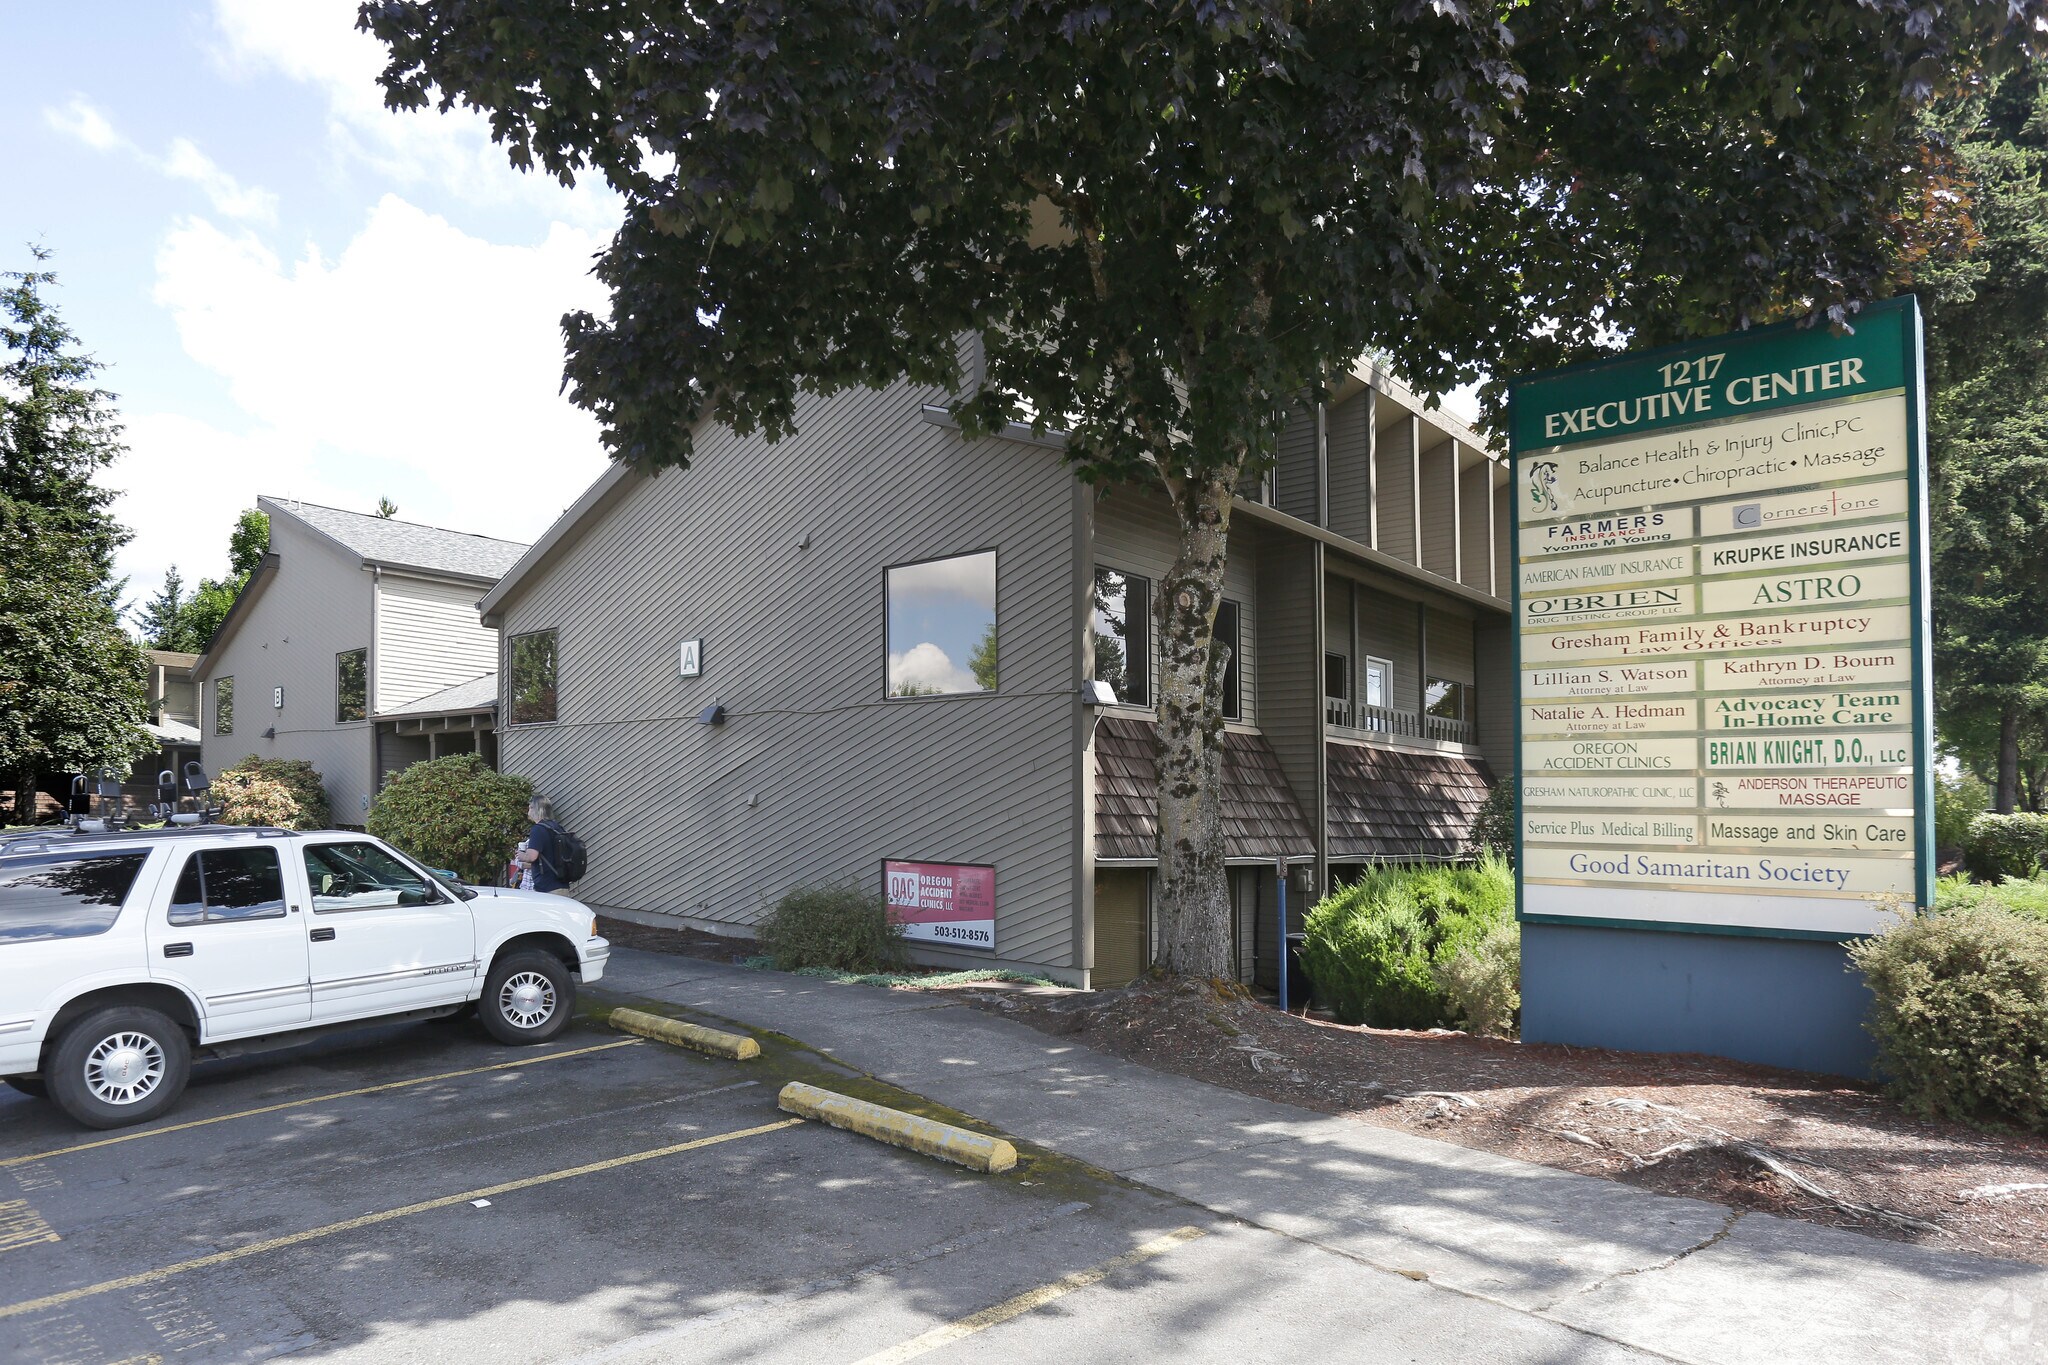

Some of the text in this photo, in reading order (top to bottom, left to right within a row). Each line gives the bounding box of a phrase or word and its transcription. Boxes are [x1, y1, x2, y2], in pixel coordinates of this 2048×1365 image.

[1657, 352, 1726, 388] 1217
[1545, 356, 1866, 439] EXECUTIVE CENTER
[1578, 454, 1639, 475] Balance
[1645, 439, 1699, 464] Health
[1706, 440, 1720, 455] &
[1725, 434, 1773, 462] Injury
[1573, 445, 1885, 505] Acupuncture Chiropractic Massage
[1548, 513, 1664, 538] FARMERS
[1565, 528, 1646, 542] INSURANCE
[1542, 533, 1671, 553] Yvonne M Young
[1713, 531, 1901, 566] KRUPKE INSURANCE
[1524, 556, 1684, 585] AMERICAN FAMILY INSURANCE
[1752, 574, 1861, 605] ASTRO
[1528, 588, 1680, 614] O'BRIEN
[1527, 616, 1560, 625] DRUG
[1566, 612, 1611, 622] TESTING
[1662, 606, 1683, 614] LLC
[1551, 617, 1871, 650] Gresham Family & Bankruptcy
[1622, 638, 1783, 655] Law Offices
[683, 645, 696, 670] A
[1723, 655, 1895, 675] Kathryn D. Bourn
[1533, 668, 1688, 686] Lillian S. Watson
[1758, 673, 1856, 686] Attorney at Law
[1568, 683, 1649, 695] Attorney at Law
[1531, 704, 1686, 721] Natalie A. Hedman
[1715, 693, 1901, 713] Advocacy Team
[1566, 720, 1647, 732] Attorney at Law
[1722, 709, 1893, 728] In-Home Care
[1573, 742, 1638, 755] OREGON
[1710, 738, 1906, 767] BRIAN KNIGHT, D.O., LLC
[1543, 756, 1671, 769] ACCIDENT CLINICS
[1523, 786, 1695, 799] GRESHAM NATUROPATHIC CLINIC, LLC
[1738, 777, 1907, 790] ANDERSON THERAPEUTIC
[1779, 793, 1861, 805] MASSAGE
[1528, 820, 1693, 843] Service Plus Medical Billing
[1711, 822, 1907, 843] Massage and Skin Care
[920, 875, 952, 887] OREGON
[1570, 853, 1851, 891] Good Samaritan Society
[891, 877, 915, 900] OAC
[920, 887, 953, 899] ACCIDENT
[945, 902, 954, 911] LLC
[934, 926, 989, 942] 503-512-8576
